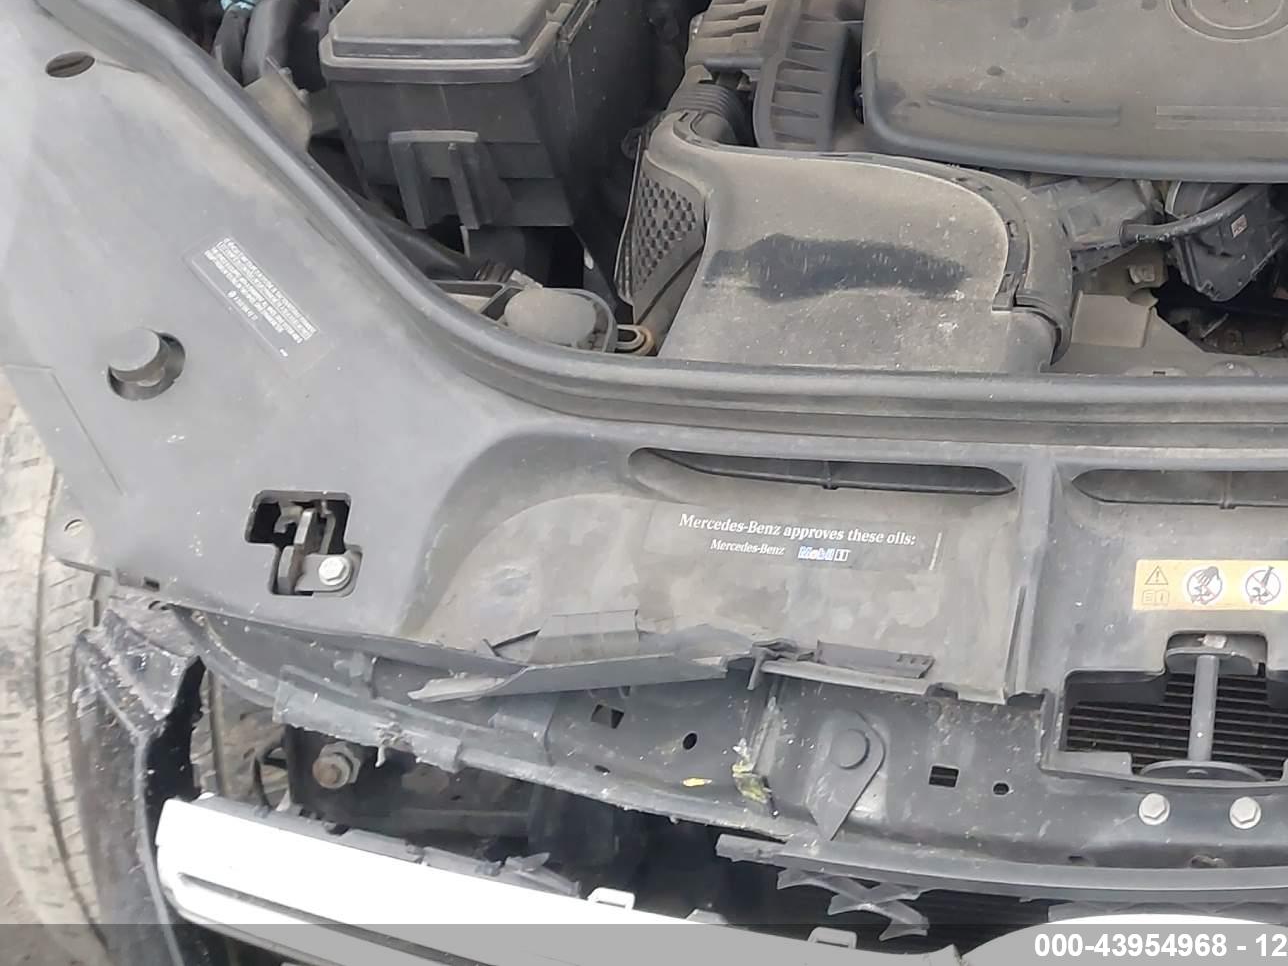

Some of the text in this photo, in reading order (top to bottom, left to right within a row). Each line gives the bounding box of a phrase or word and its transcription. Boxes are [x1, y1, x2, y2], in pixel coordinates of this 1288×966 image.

[679, 513, 917, 546] Mercedes-Benz approves these oils:
[710, 538, 785, 556] Mercedes-Benz
